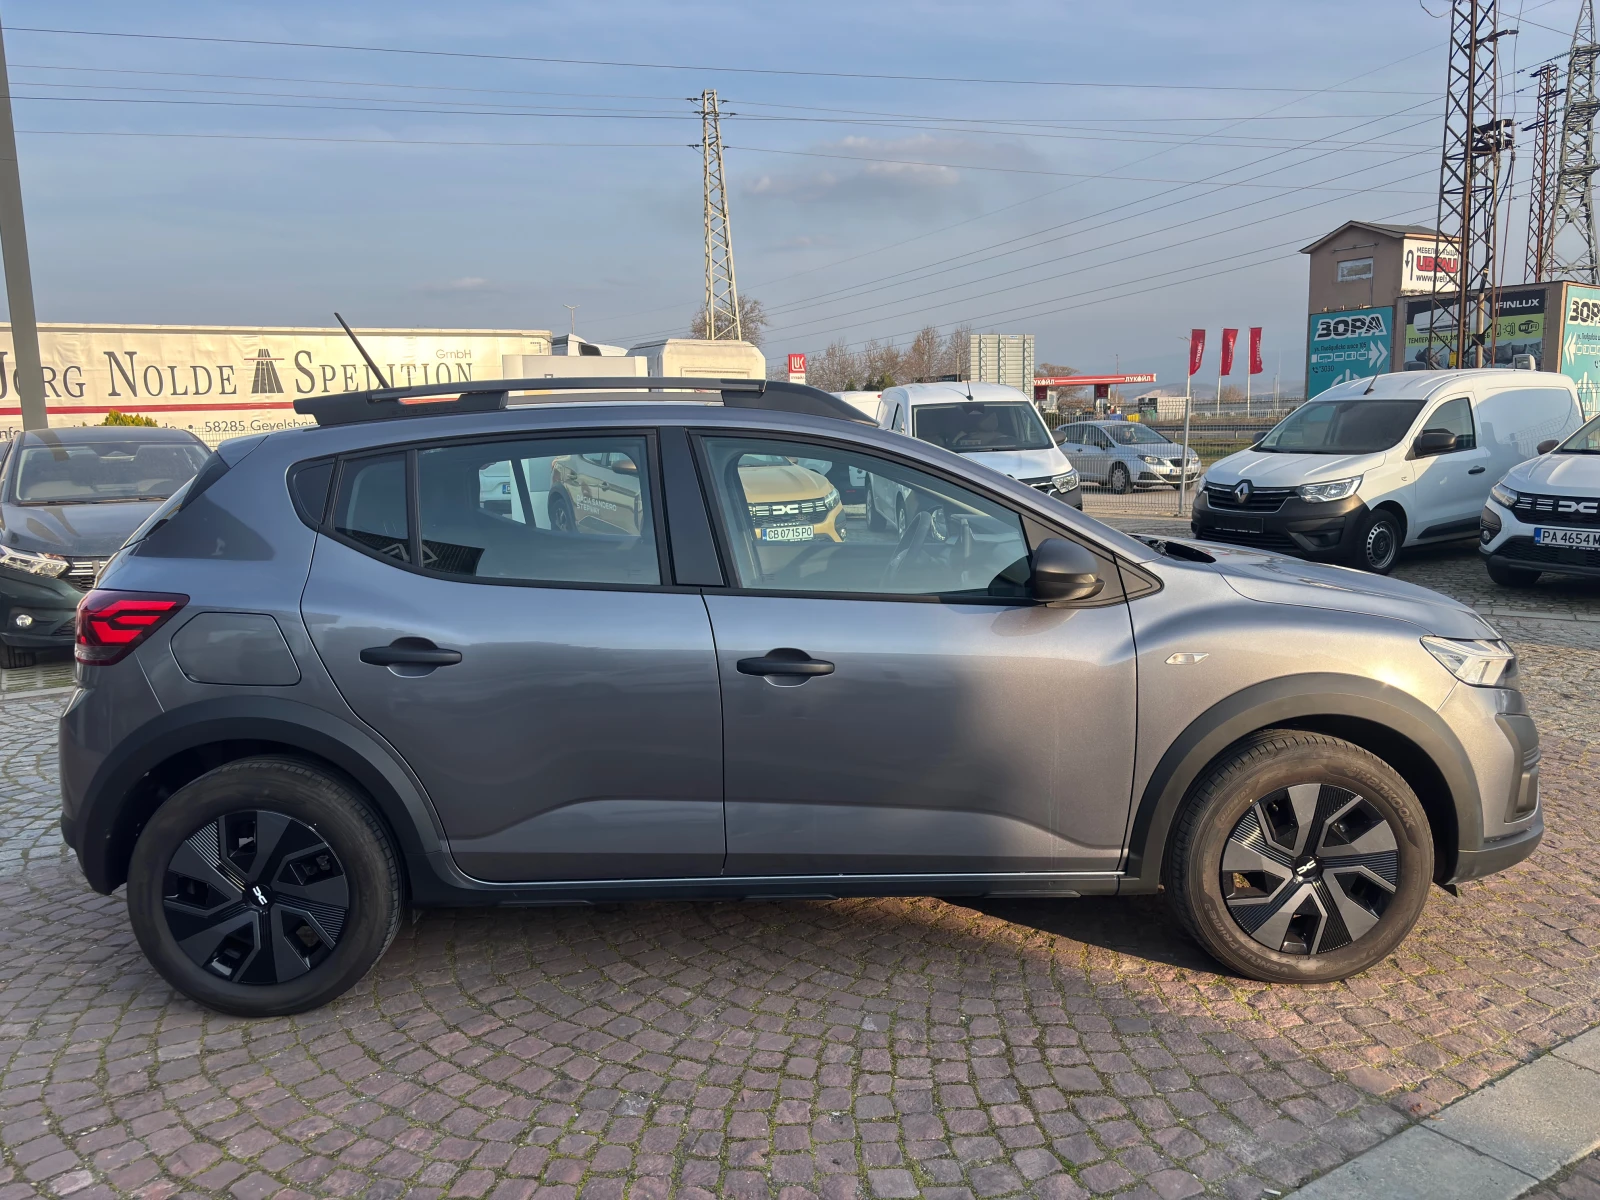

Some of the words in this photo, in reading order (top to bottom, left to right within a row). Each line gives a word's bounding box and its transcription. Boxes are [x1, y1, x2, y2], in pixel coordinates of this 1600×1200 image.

[1495, 298, 1540, 310] FINLUX
[1567, 297, 1600, 326] ЗОР
[1314, 314, 1387, 341] ЗОРА
[1408, 335, 1448, 344] ТЕМПЕРТУРТА
[436, 349, 471, 359] GmbH
[0, 352, 86, 399] JRG
[103, 351, 237, 397] NOLDE
[205, 421, 246, 432] 58285
[780, 528, 801, 538] 0715
[1542, 530, 1558, 543] PA
[1560, 532, 1591, 545] 4654
